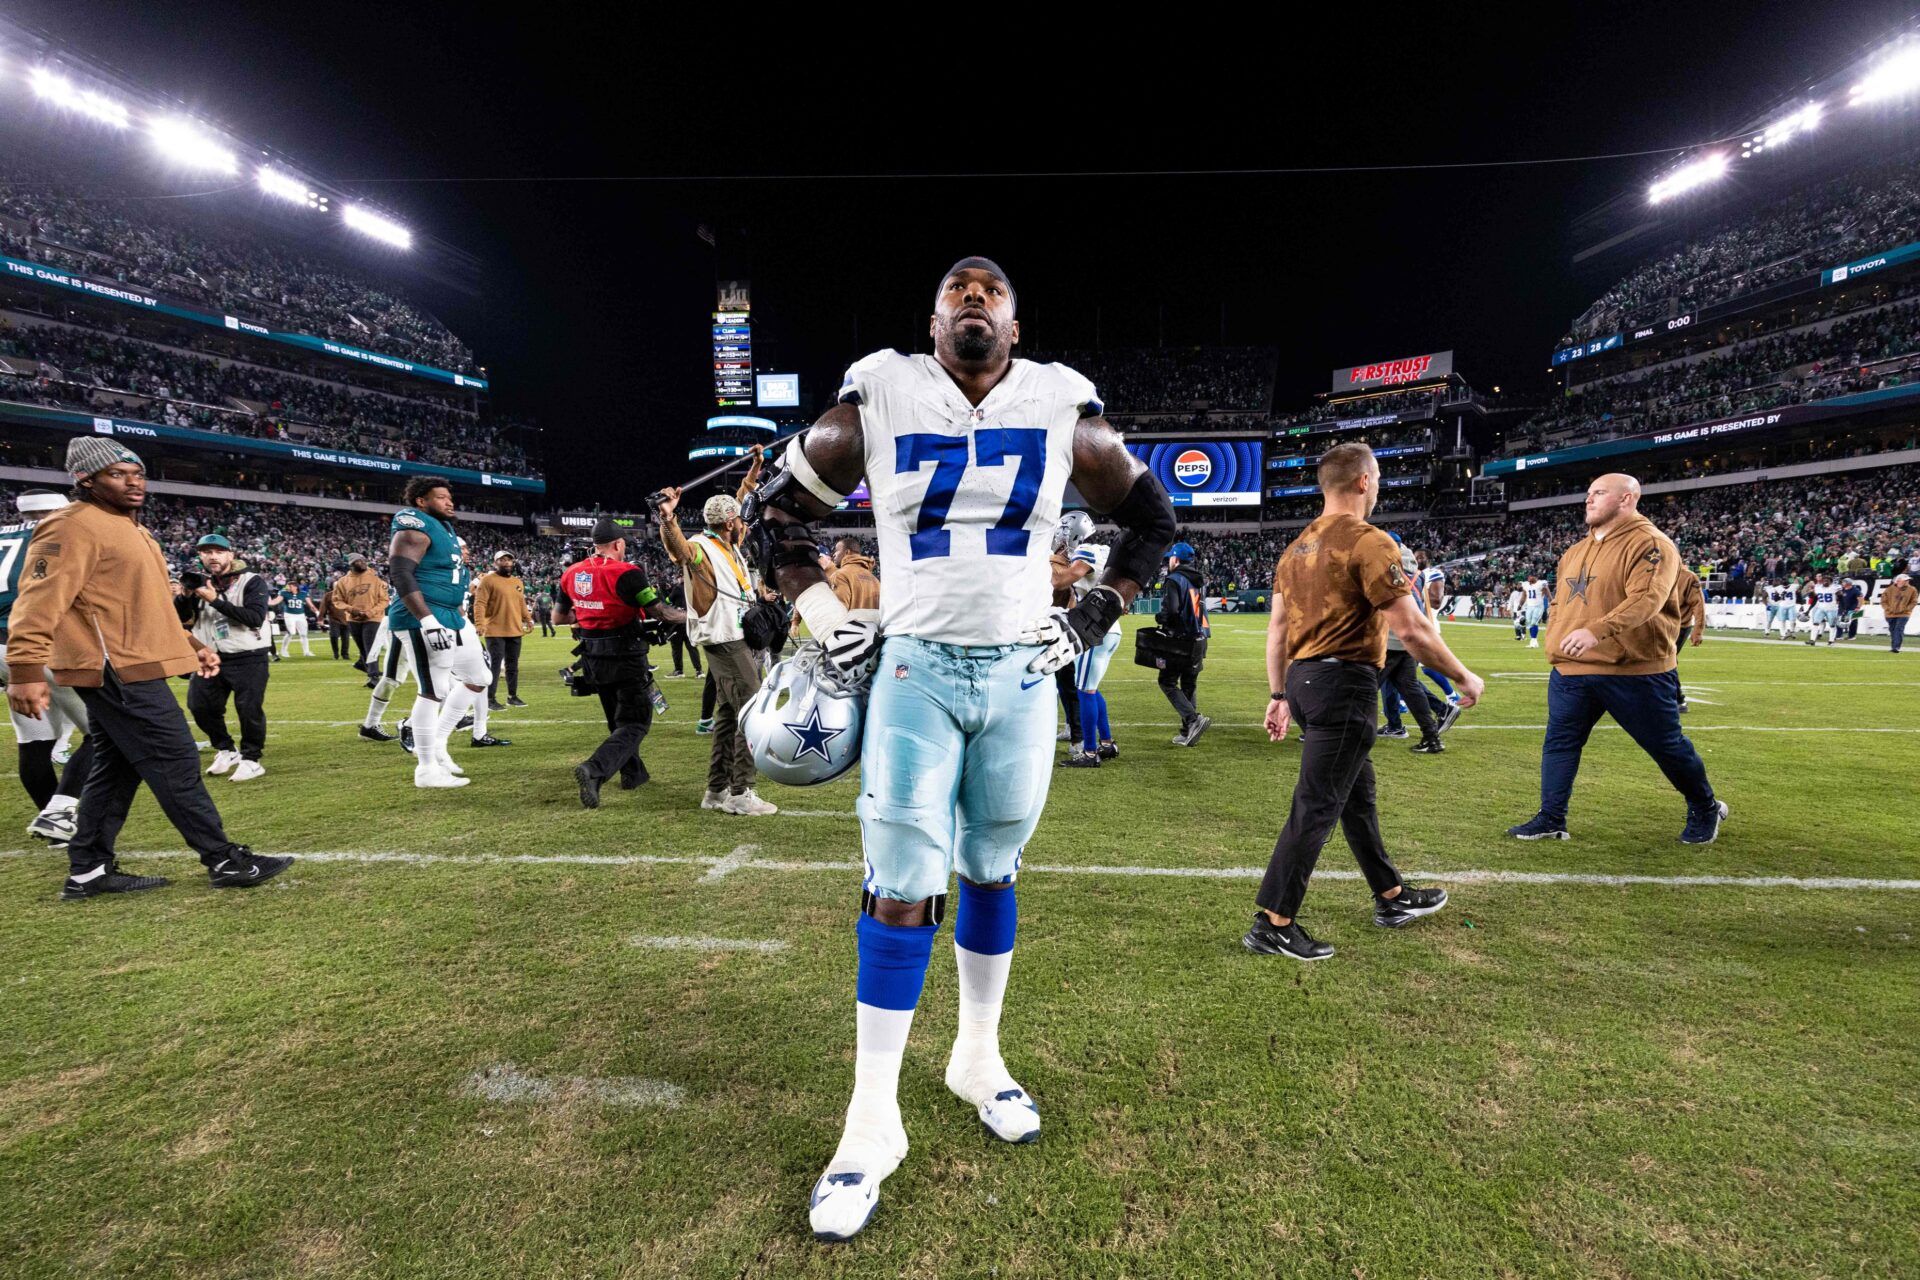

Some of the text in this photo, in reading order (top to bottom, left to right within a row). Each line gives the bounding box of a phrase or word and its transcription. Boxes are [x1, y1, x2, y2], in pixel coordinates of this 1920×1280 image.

[1849, 258, 1887, 274] TOYOTA
[7, 262, 157, 307] THIS GAME IS PRESENTED BY
[240, 322, 269, 335] TOYOTA
[1667, 316, 1691, 329] 0:00
[1635, 328, 1654, 339] FINAL
[1572, 349, 1582, 359] 23
[1590, 343, 1601, 352] 28
[323, 343, 340, 353] THIS
[341, 347, 360, 358] GAME
[369, 354, 404, 369] PRESENTED
[405, 363, 413, 371] BY
[463, 379, 483, 388] TOYOTA
[1383, 372, 1421, 385] BANK
[115, 424, 157, 437] TOYOTA
[1653, 414, 1781, 444] THIS GAME IS PRESENTED BY
[292, 449, 312, 459] THIS
[313, 452, 337, 462] GAME
[338, 456, 347, 464] IS
[348, 457, 390, 469] PRESENTED
[1526, 456, 1549, 466] TOYOTA
[1177, 464, 1209, 472] PEPSI
[492, 478, 512, 486] TOYOTA
[894, 428, 1049, 561] 77
[1528, 590, 1536, 599] 11
